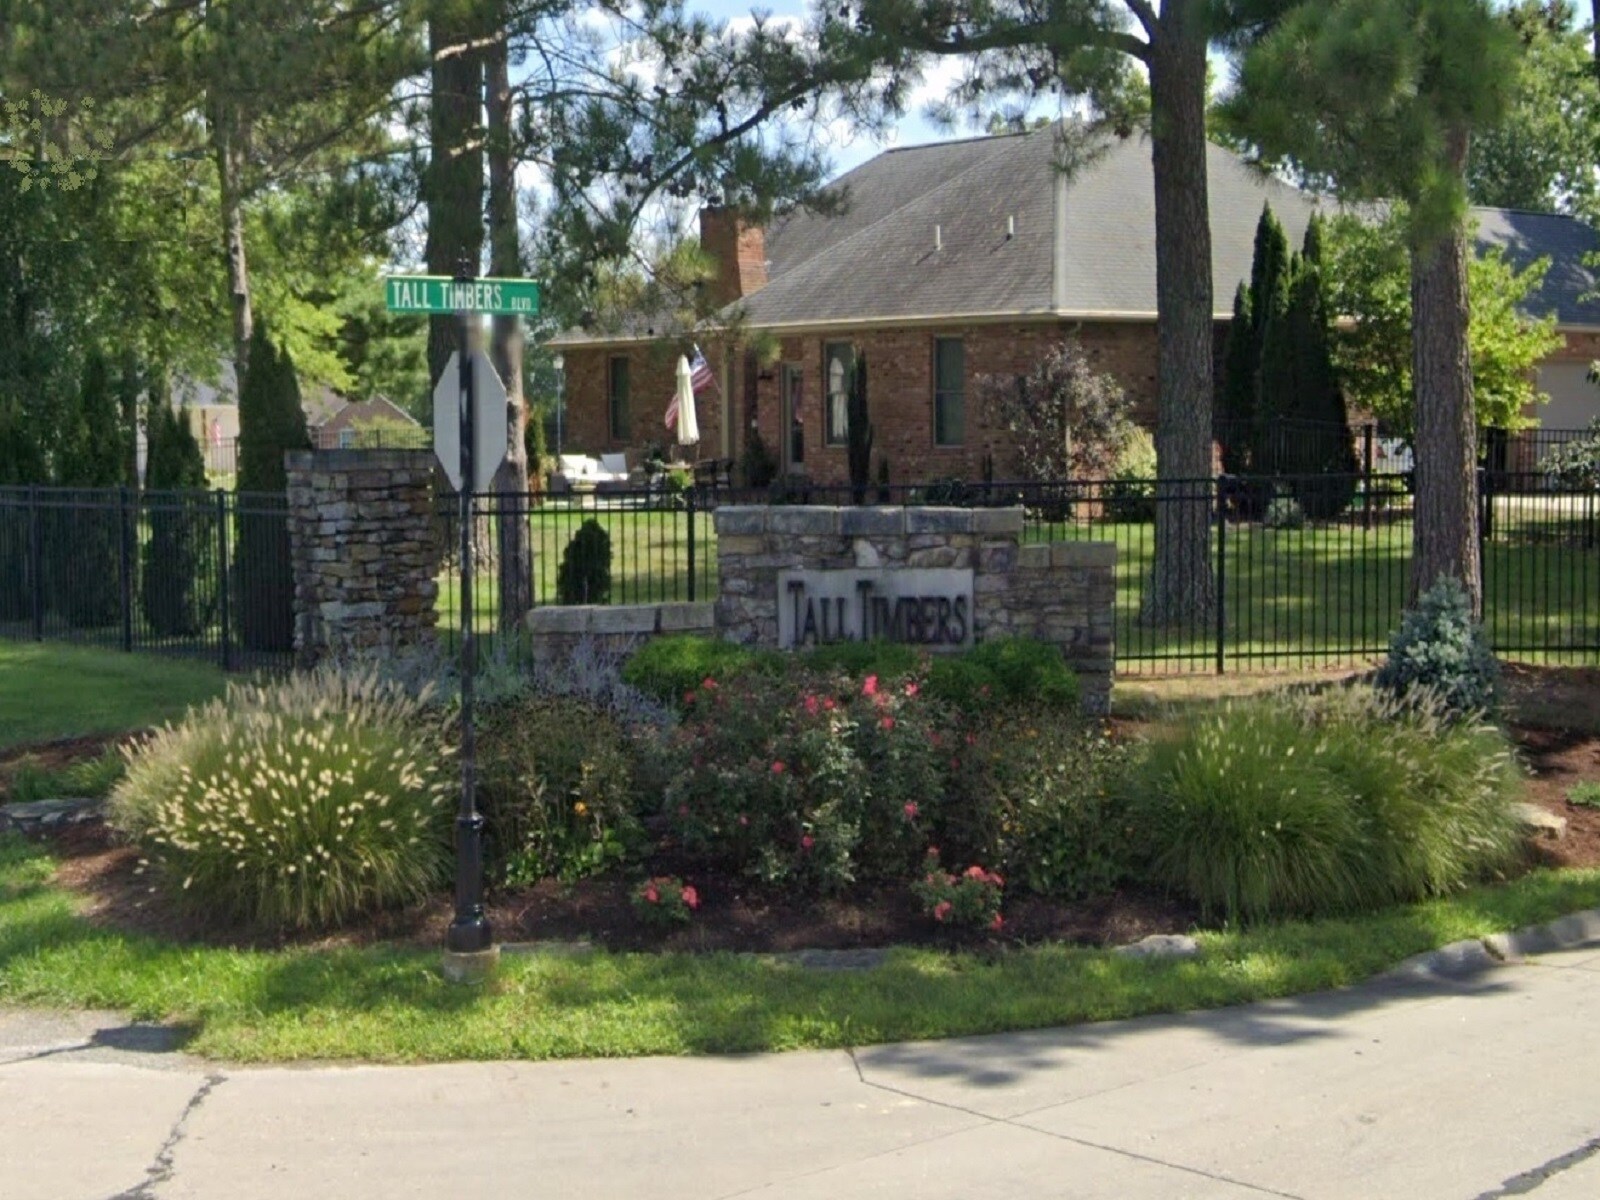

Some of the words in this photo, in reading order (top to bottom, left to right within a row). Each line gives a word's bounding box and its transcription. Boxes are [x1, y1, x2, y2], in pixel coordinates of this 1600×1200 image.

[393, 281, 432, 309] TALL
[440, 283, 503, 310] TIMBERS
[511, 297, 532, 311] BLVD
[787, 579, 853, 645] TALL
[855, 579, 968, 645] TIMBERS
